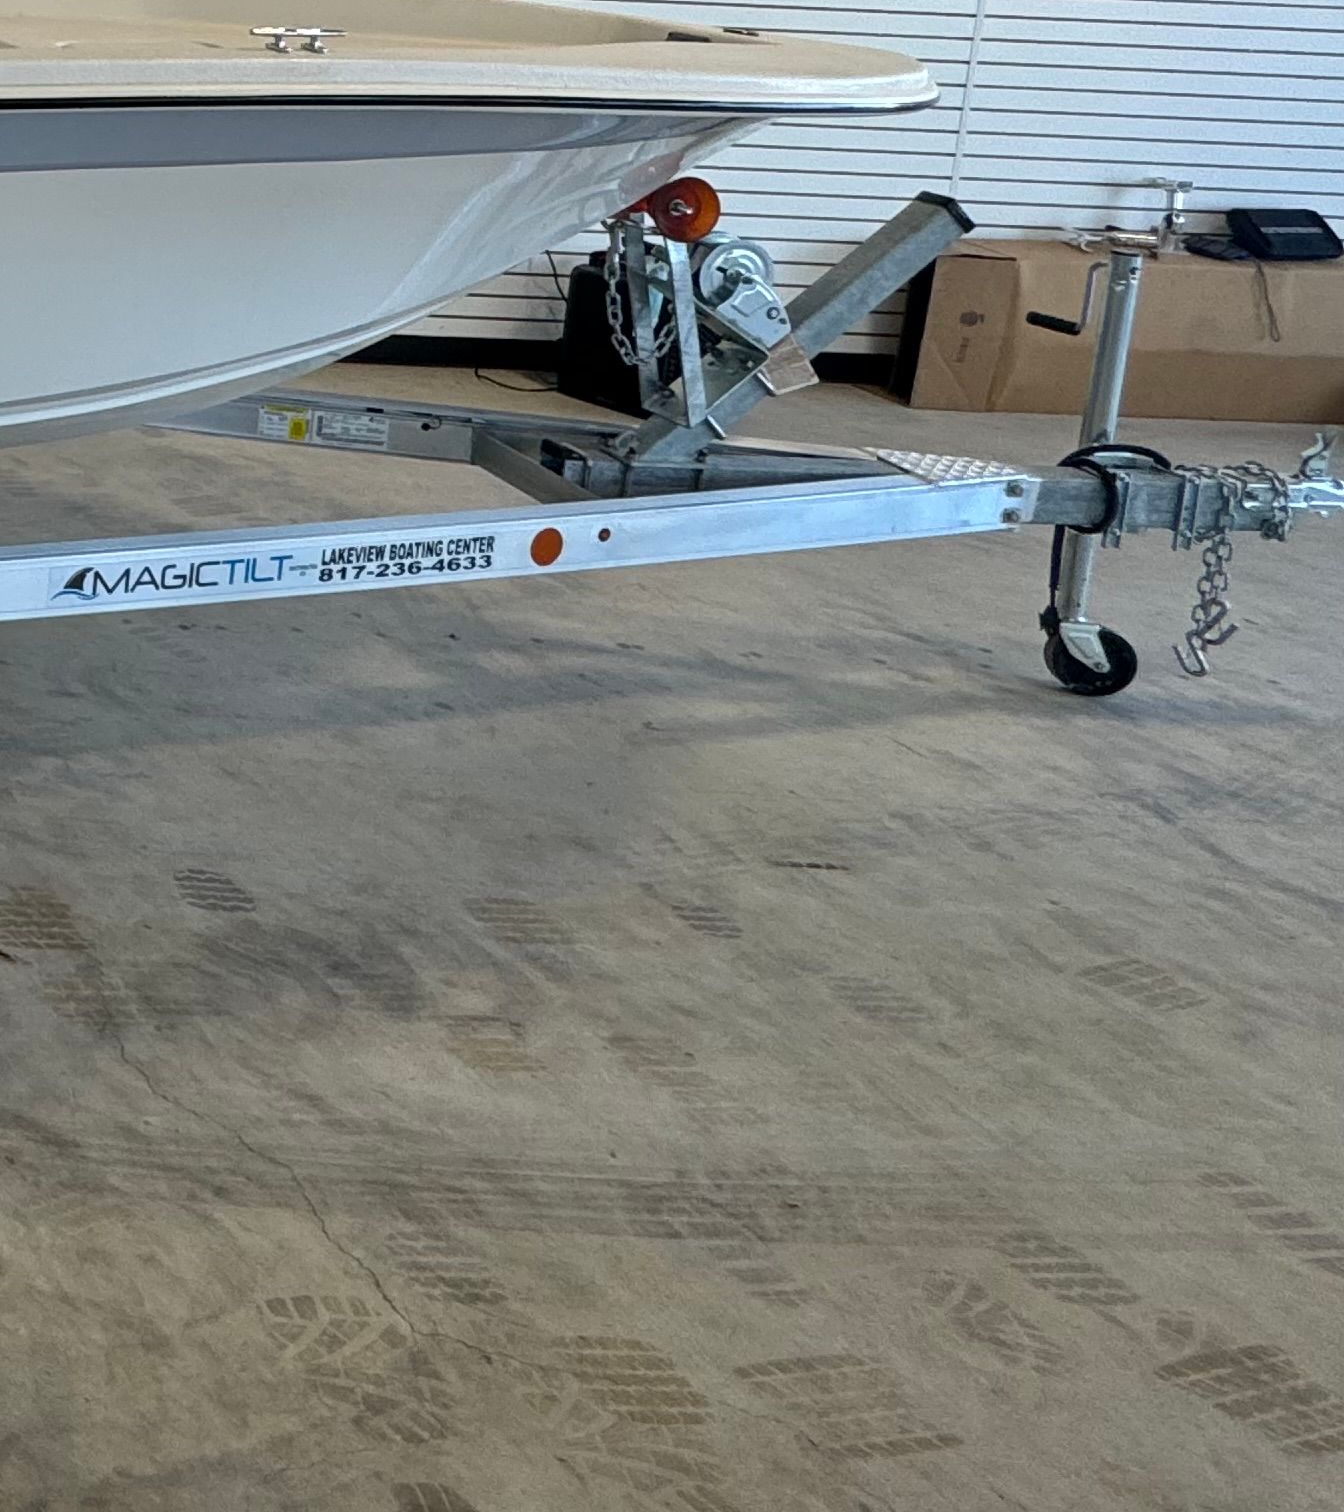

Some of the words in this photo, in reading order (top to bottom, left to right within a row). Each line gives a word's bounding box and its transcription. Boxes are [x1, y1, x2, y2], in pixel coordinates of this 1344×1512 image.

[321, 544, 387, 566] LAKEVIEW
[389, 540, 444, 561] BOATING
[447, 535, 496, 555] CENTER
[92, 554, 294, 596] MAGICTILT
[318, 554, 493, 582] 817-236-4633
